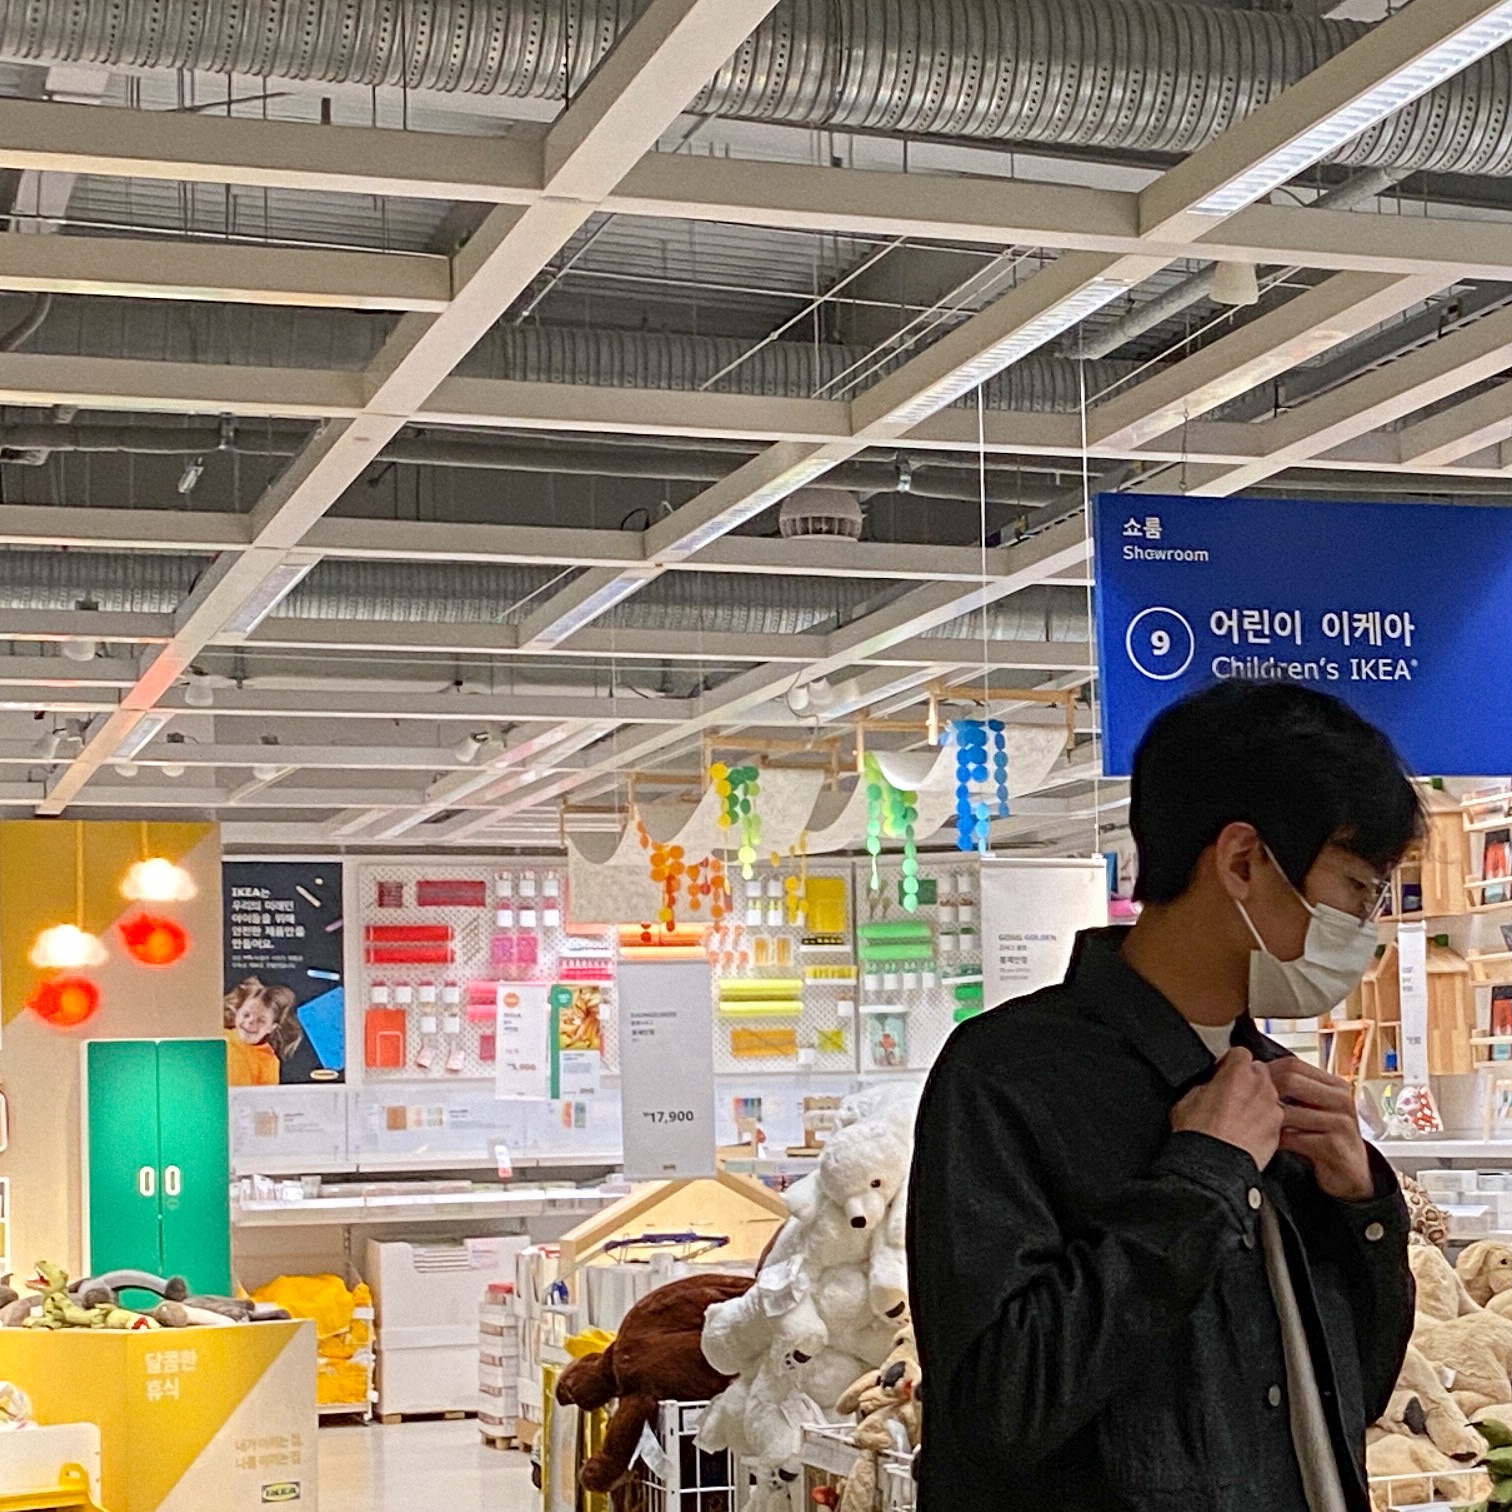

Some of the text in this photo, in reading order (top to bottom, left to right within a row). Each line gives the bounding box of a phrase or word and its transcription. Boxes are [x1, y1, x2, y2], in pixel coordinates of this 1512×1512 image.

[1122, 516, 1163, 540] 쇼룸
[1122, 545, 1210, 562] Showroom
[1209, 608, 1416, 648] 어린이 이케아
[1150, 630, 1171, 656] 9
[145, 1377, 180, 1402] 휴식
